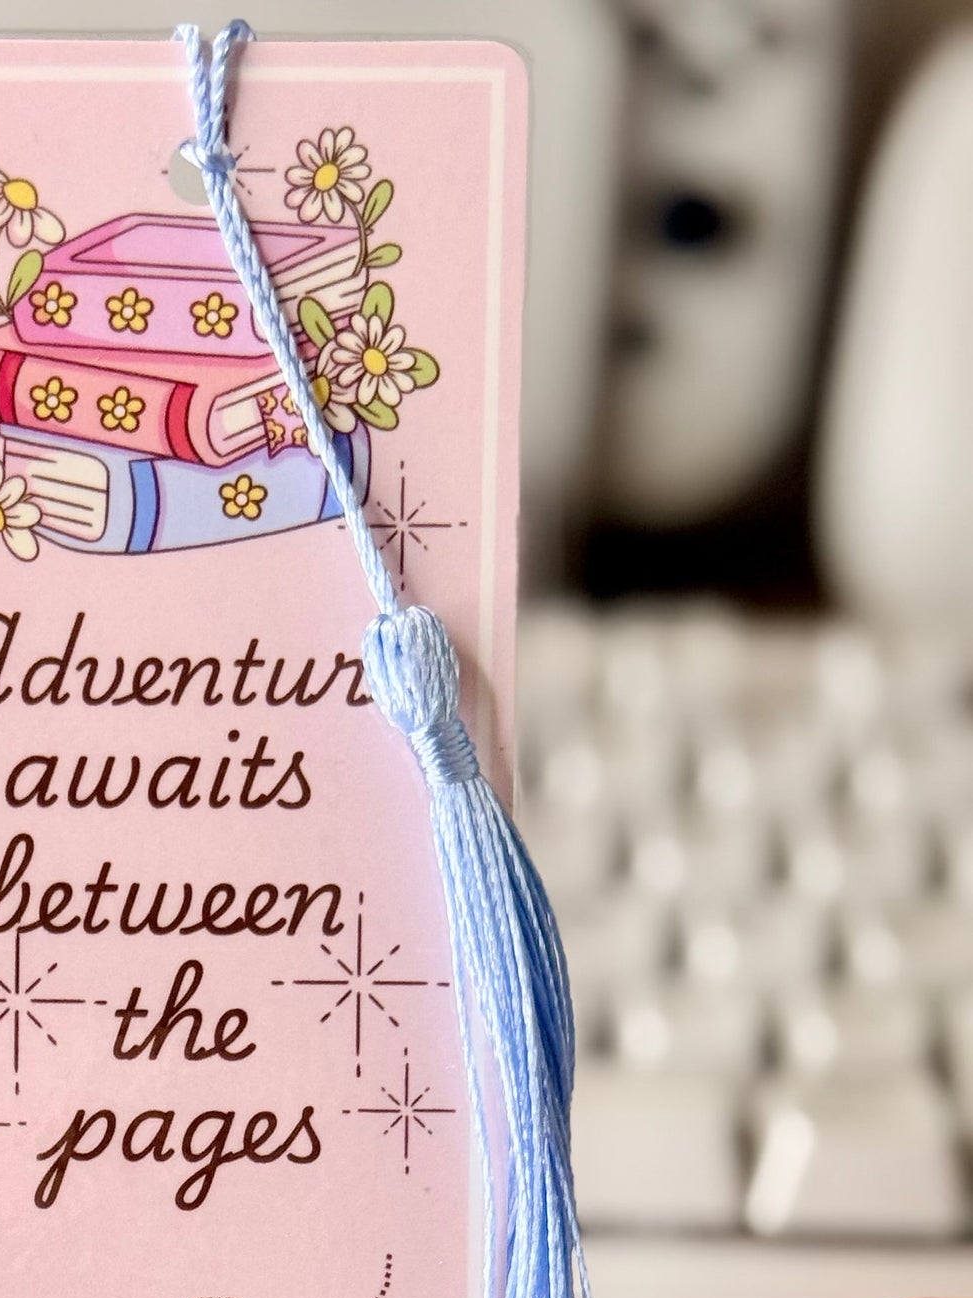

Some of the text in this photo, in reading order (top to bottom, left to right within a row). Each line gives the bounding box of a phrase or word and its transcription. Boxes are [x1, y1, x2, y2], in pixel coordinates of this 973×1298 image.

[4, 728, 312, 811] awaits
[112, 958, 258, 1062] the
[33, 1104, 323, 1213] pages
